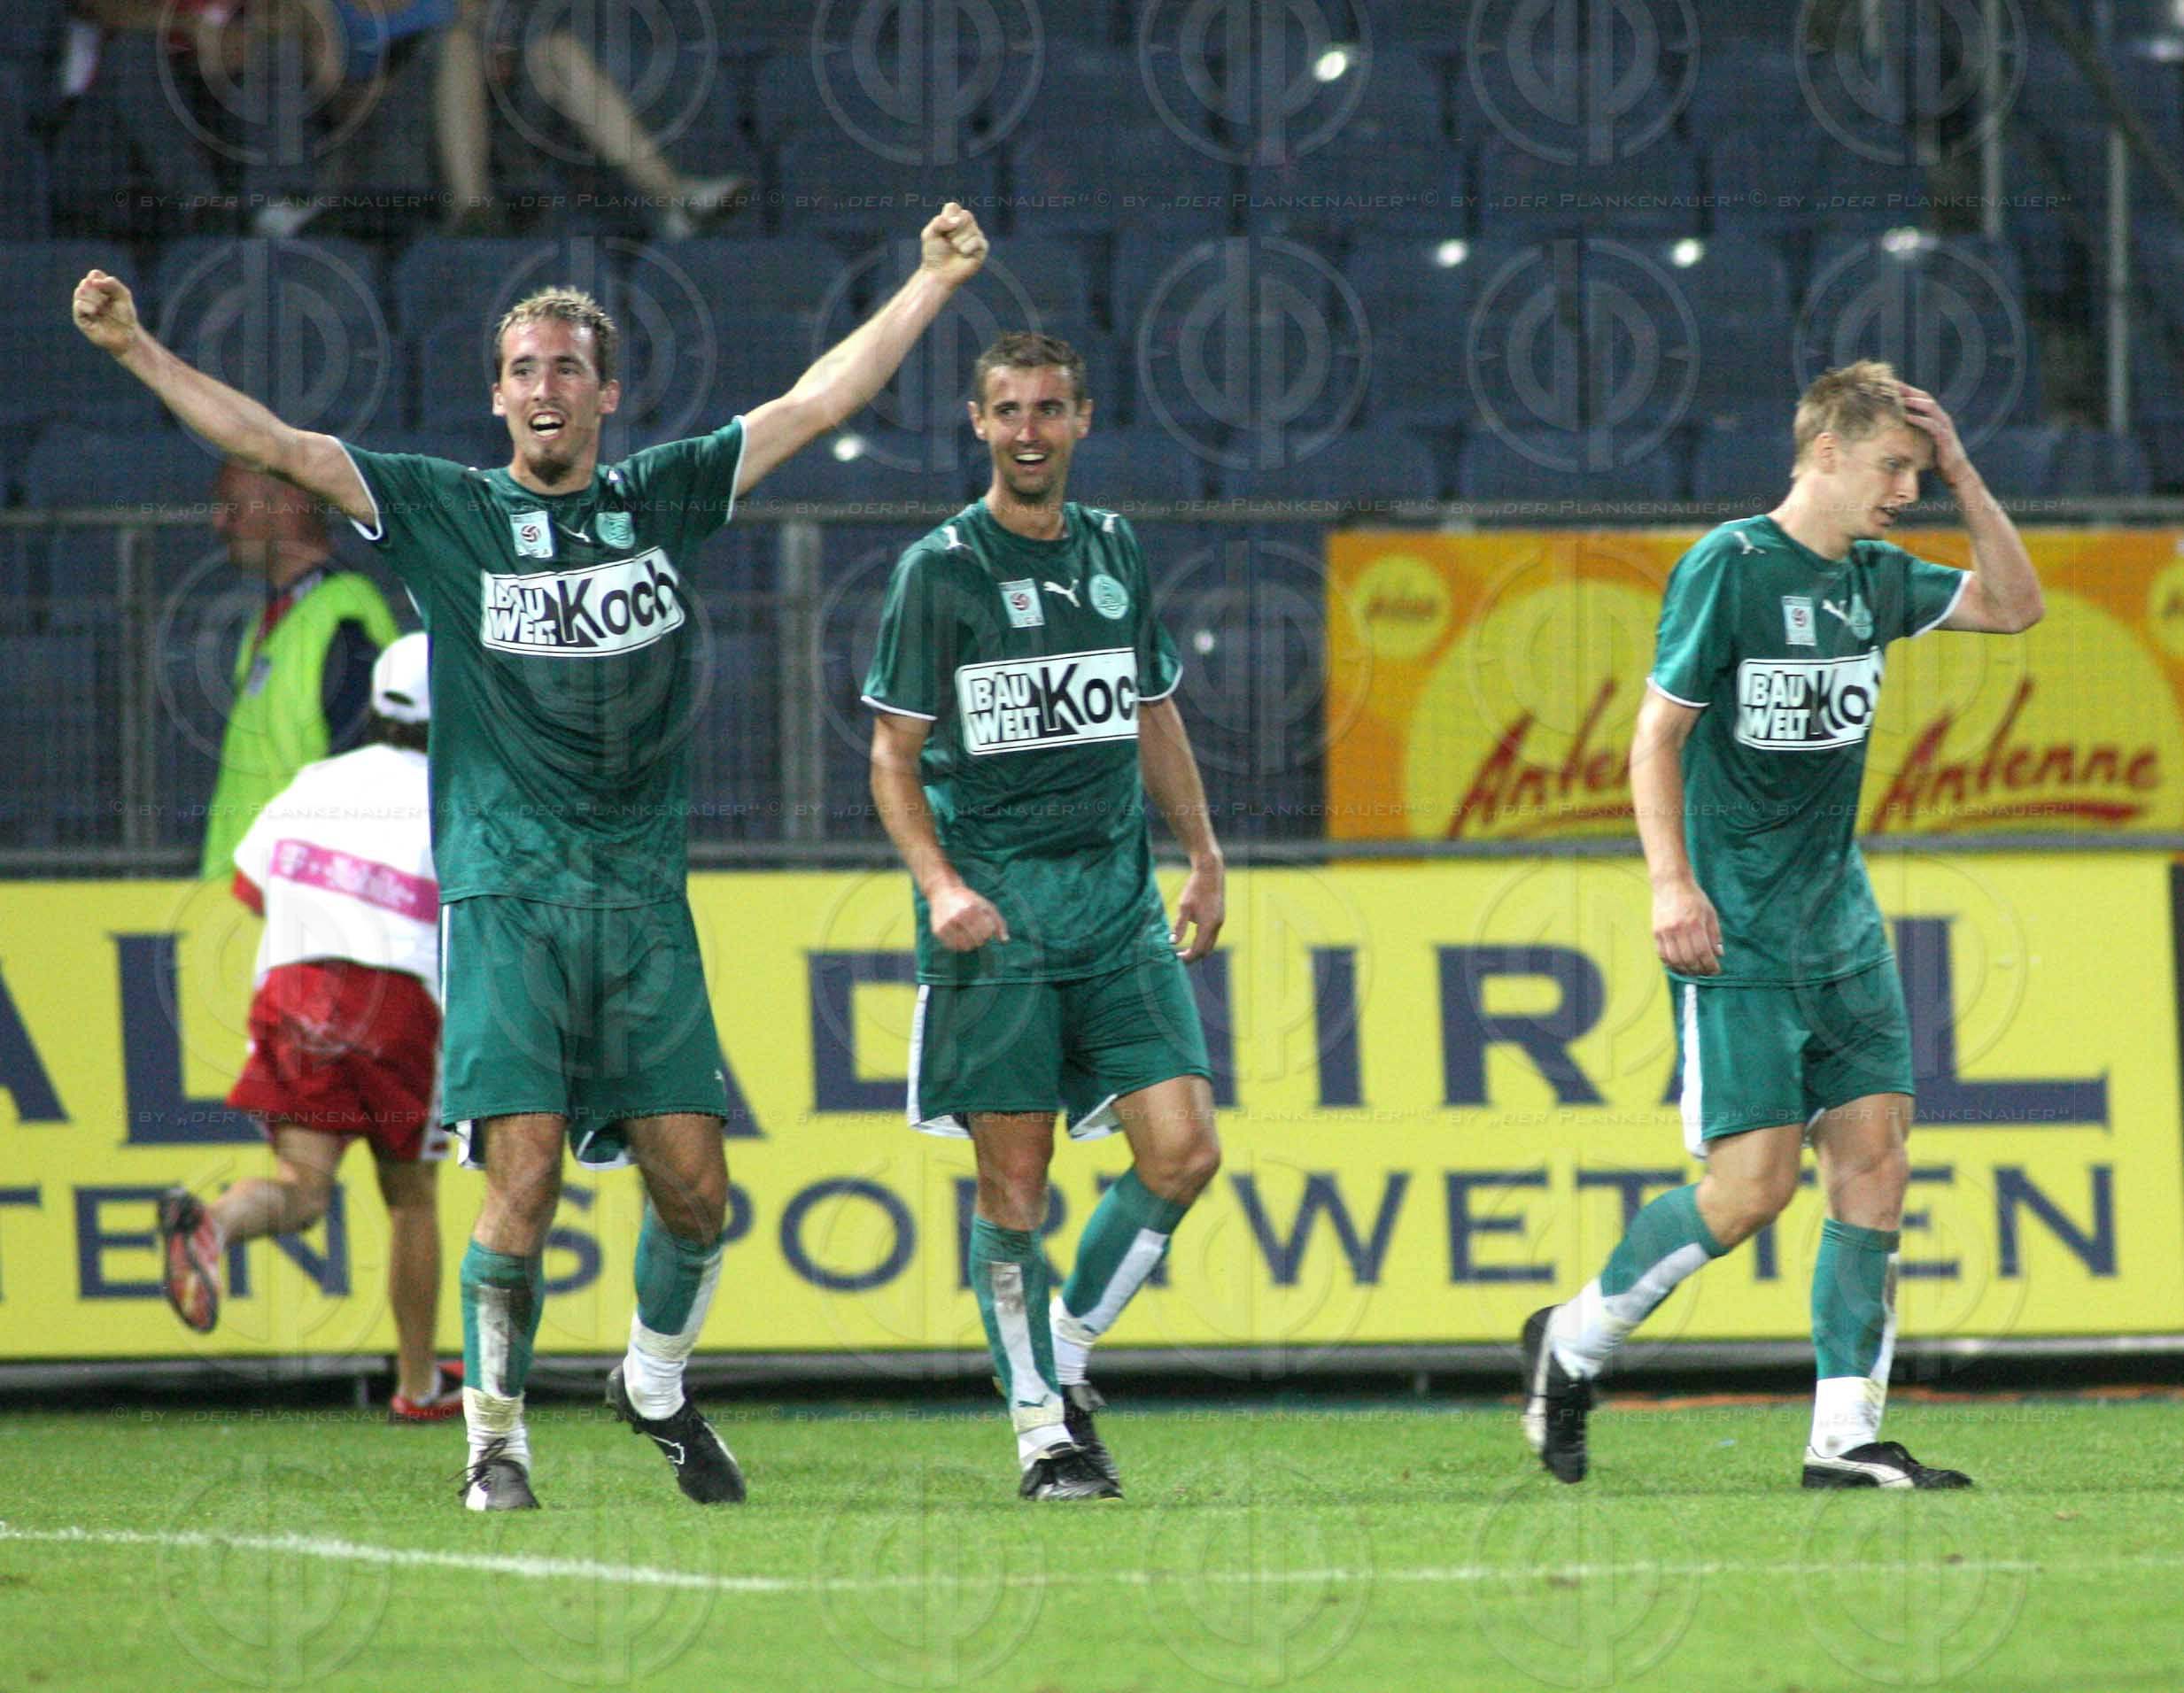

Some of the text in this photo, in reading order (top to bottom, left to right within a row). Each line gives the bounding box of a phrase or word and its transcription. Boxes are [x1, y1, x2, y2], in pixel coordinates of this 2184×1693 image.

[971, 672, 1031, 710] BAU
[1040, 663, 1137, 731] Koc
[1751, 670, 1806, 707] BAU
[973, 707, 1041, 745] WELT
[1743, 708, 1810, 740] WELT
[1445, 679, 1632, 841] Ante
[1869, 676, 2161, 833] Antenne
